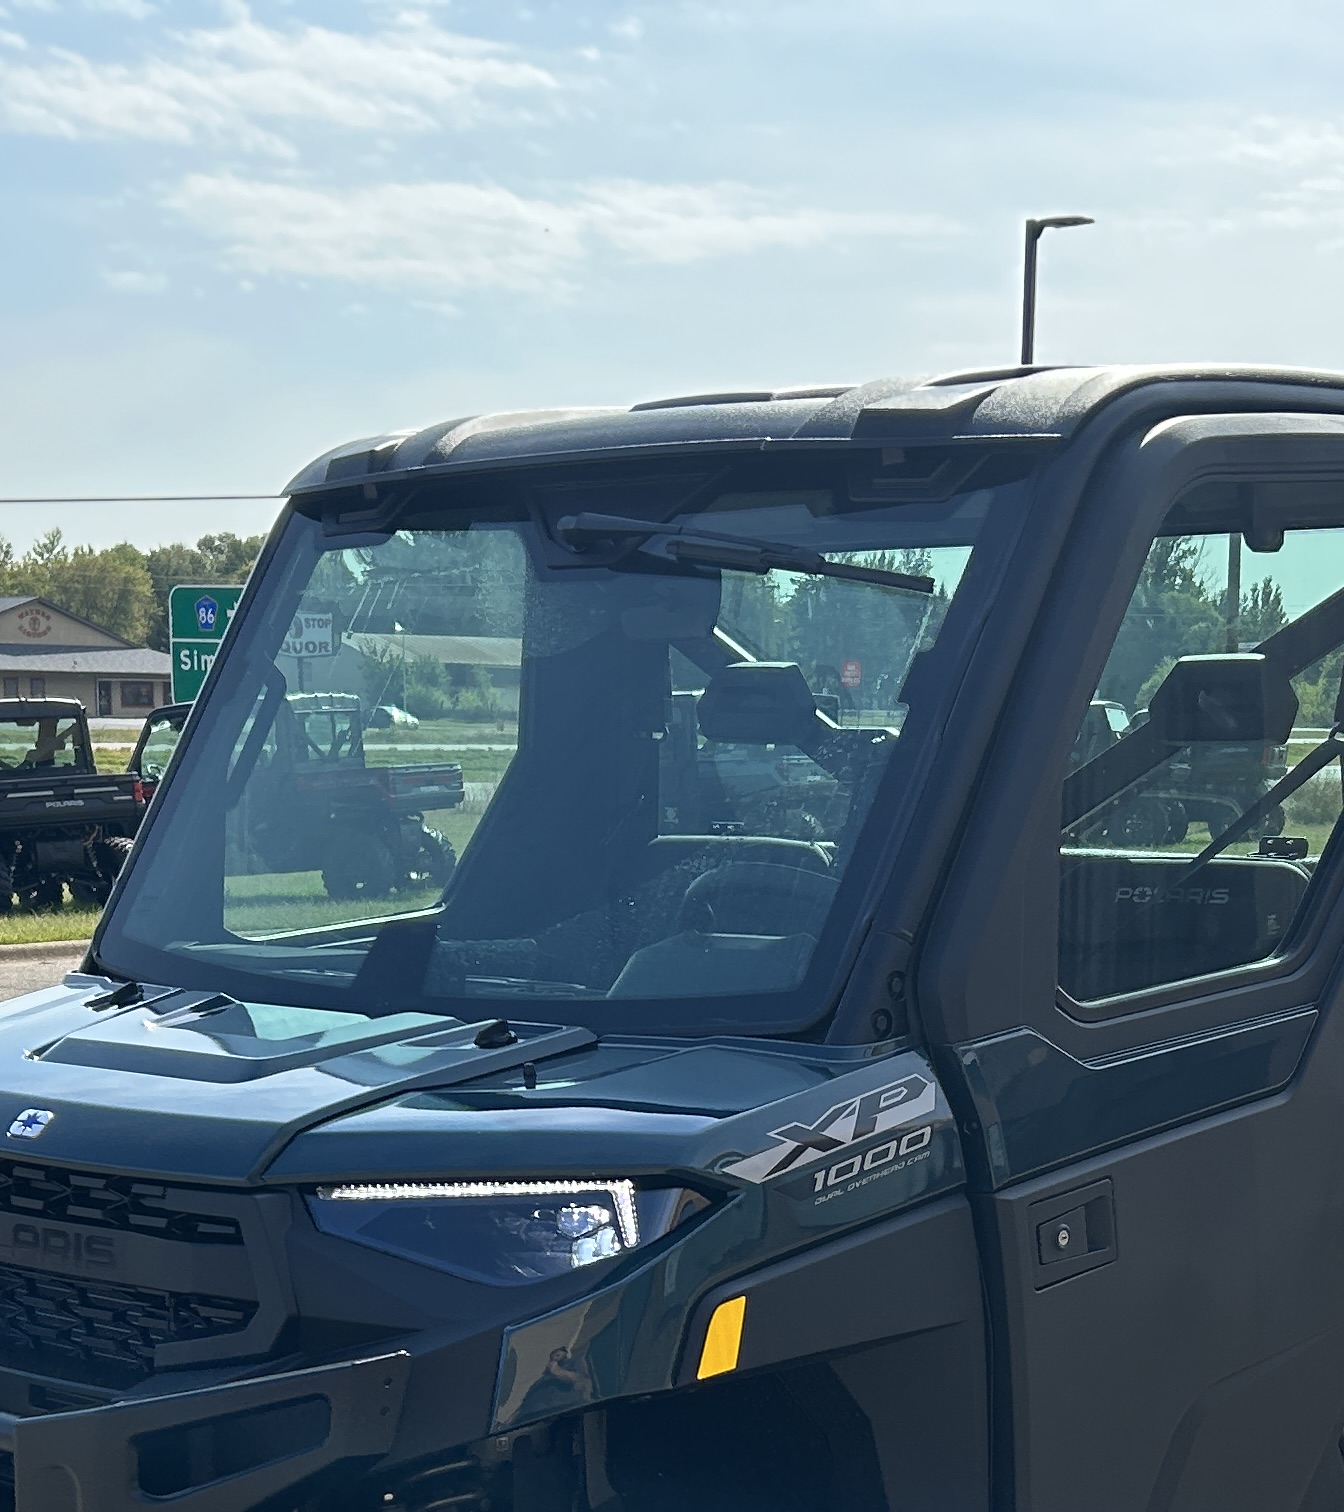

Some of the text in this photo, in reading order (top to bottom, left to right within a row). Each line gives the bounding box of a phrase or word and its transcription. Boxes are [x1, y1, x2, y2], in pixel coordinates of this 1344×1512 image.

[198, 607, 215, 624] 86
[303, 617, 332, 630] STOP
[45, 799, 85, 808] POLARIS
[761, 1073, 930, 1180] XP
[813, 1125, 932, 1193] 1000
[814, 1150, 931, 1206] DUAL OVERHEAD CAM
